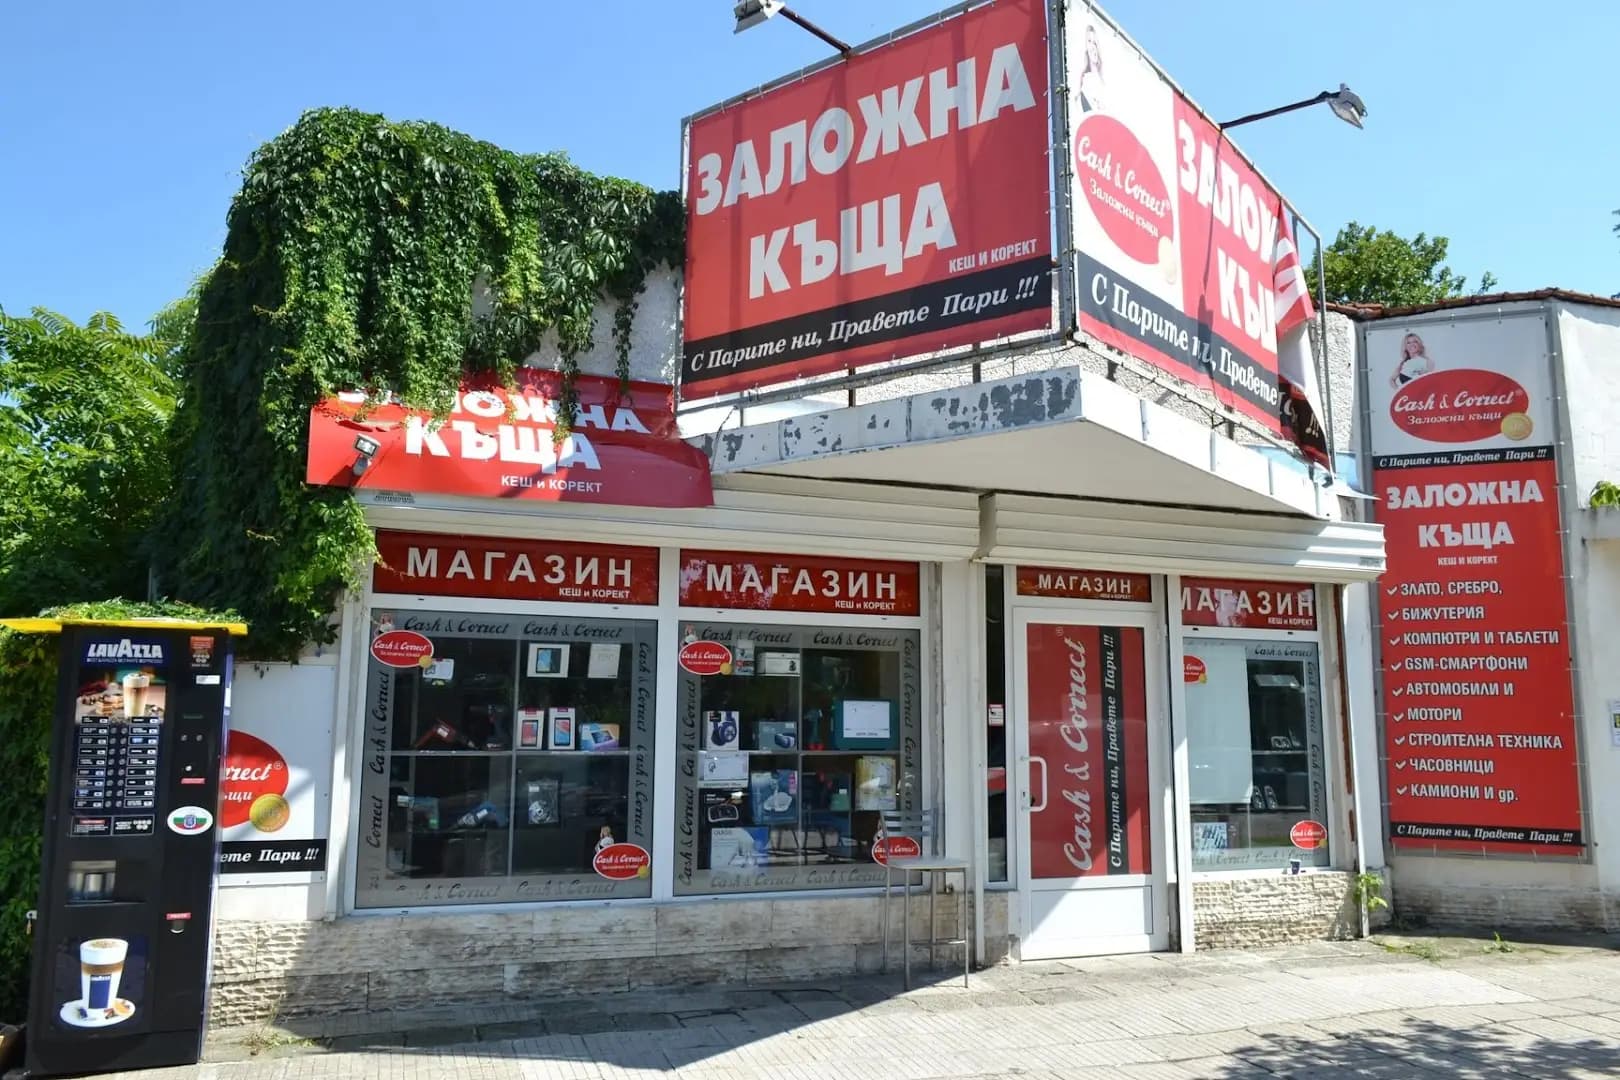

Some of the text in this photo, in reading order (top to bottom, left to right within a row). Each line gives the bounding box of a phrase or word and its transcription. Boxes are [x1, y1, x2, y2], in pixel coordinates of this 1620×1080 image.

[696, 42, 1037, 216] ЗАЛОЖНА
[1078, 136, 1112, 181] Cash
[1114, 162, 1122, 189] &
[748, 181, 957, 300] КЪЩА
[949, 239, 1039, 275] КЕШ И КОРЕКТ
[691, 351, 706, 373] С
[707, 333, 786, 372] Парите
[791, 328, 823, 350] ни,
[829, 302, 930, 343] Правете
[940, 285, 1009, 319] Пари
[1092, 273, 1107, 305] С
[1112, 283, 1188, 352] Парите
[1220, 347, 1278, 407] Правете
[1394, 391, 1514, 412] Cash & Correct
[1408, 412, 1502, 425] Заложни къщи
[405, 412, 602, 474] КЪЩА
[1380, 459, 1388, 467] С
[1388, 456, 1432, 469] Парите
[1452, 452, 1501, 466] Правете
[1505, 450, 1535, 462] Пари
[501, 475, 603, 494] КЕШ и КОРЕКТ
[1386, 479, 1544, 510] ЗАЛОЖНА
[1418, 521, 1515, 550] КЪЩА
[407, 546, 632, 588] МАГАЗИН
[1437, 557, 1457, 566] КЕШ
[1467, 555, 1498, 566] КОРЕКТ
[706, 564, 896, 600] МАГАЗИН
[1038, 574, 1132, 595] МАГАЗИН
[1400, 580, 1503, 597] ЗЛАТО, СРЕБРО,
[559, 588, 582, 597] КЕШ
[592, 588, 630, 599] КОРЕКТ
[835, 600, 855, 609] КЕШ
[863, 601, 895, 611] КОРЕКТ
[1402, 606, 1485, 621] БИЖУТЕРИЯ
[404, 616, 440, 632] Cash
[523, 620, 559, 636] Cash
[1289, 618, 1313, 627] КОРЕКТ
[701, 627, 733, 641] Cash
[813, 630, 843, 645] Cash
[1403, 630, 1560, 645] КОМПЮТРИ И ТАБЛЕТИ
[87, 639, 163, 659] LAVAZZA
[1104, 655, 1119, 690] Пари
[1404, 656, 1529, 671] GSM-СМАРТФОНИ
[1406, 682, 1514, 697] АВТОМОБИЛИ И
[1407, 708, 1462, 721] МОТОРИ
[1106, 696, 1120, 762] Правете
[1408, 733, 1562, 749] СТРОИТЕЛНА ТЕХНИКА
[1060, 637, 1093, 871] Cash & Correct
[1410, 758, 1494, 775] ЧАСОВНИЦИ
[1410, 783, 1480, 799] КАМИОНИ
[1484, 786, 1494, 799] И
[1109, 796, 1123, 849] Парите
[1397, 825, 1405, 834] С
[1407, 826, 1453, 840] Парите
[1473, 826, 1525, 841] Правете
[1529, 830, 1560, 843] Пари
[258, 849, 301, 864] Пари
[1111, 855, 1122, 868] С
